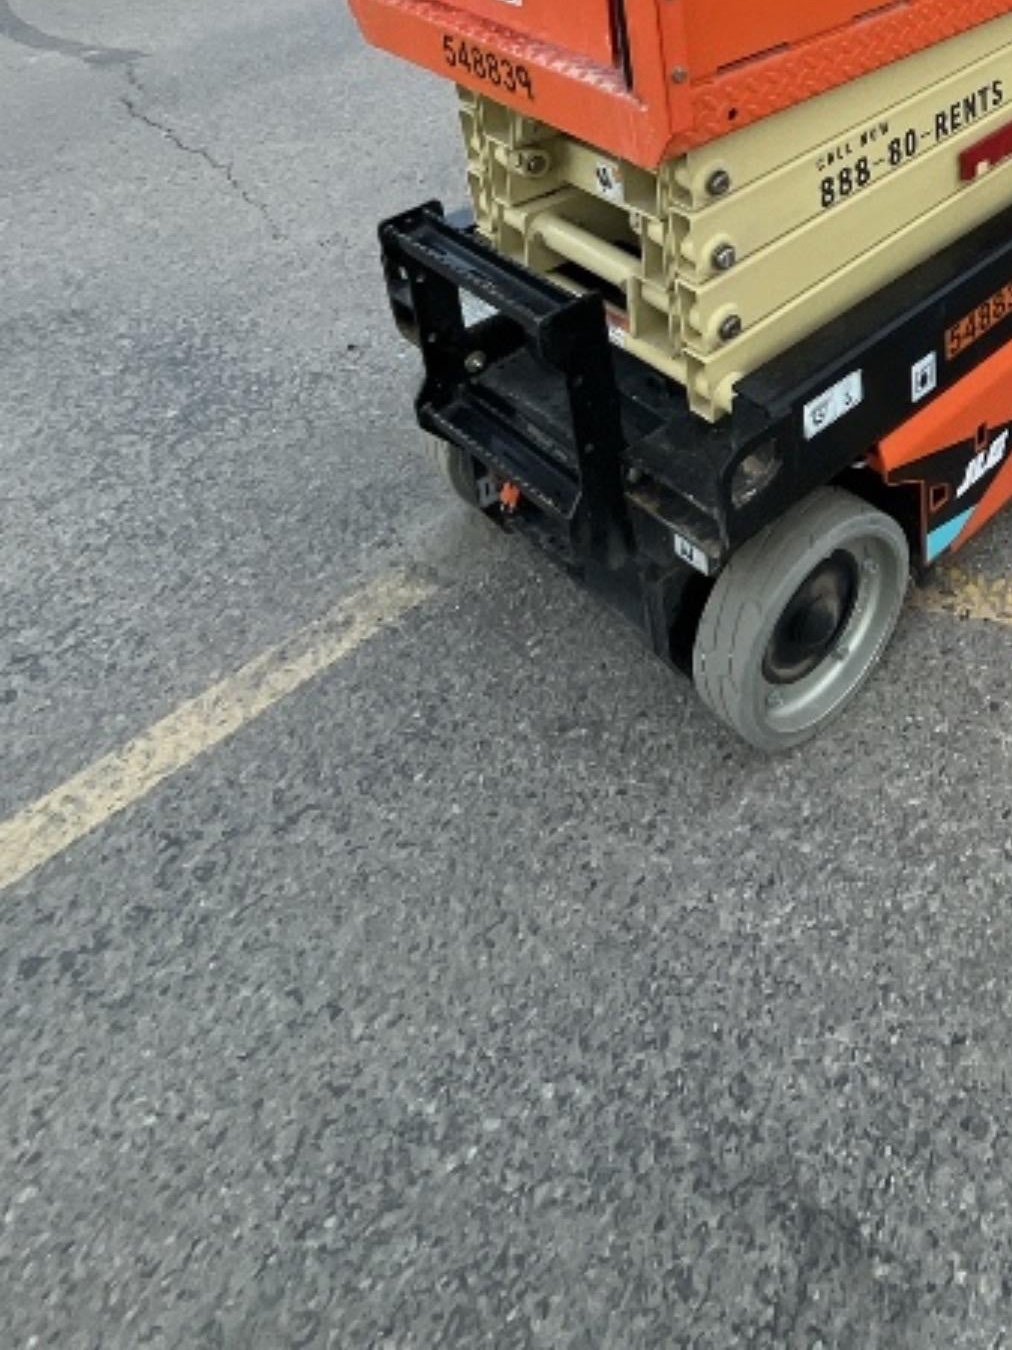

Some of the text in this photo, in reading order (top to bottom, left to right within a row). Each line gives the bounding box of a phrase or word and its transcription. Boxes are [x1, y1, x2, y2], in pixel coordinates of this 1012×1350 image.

[443, 34, 534, 100] 548839
[816, 121, 890, 171] CALL NOW
[820, 80, 1004, 208] 888-80-RENTS
[955, 428, 1009, 499] JLG
